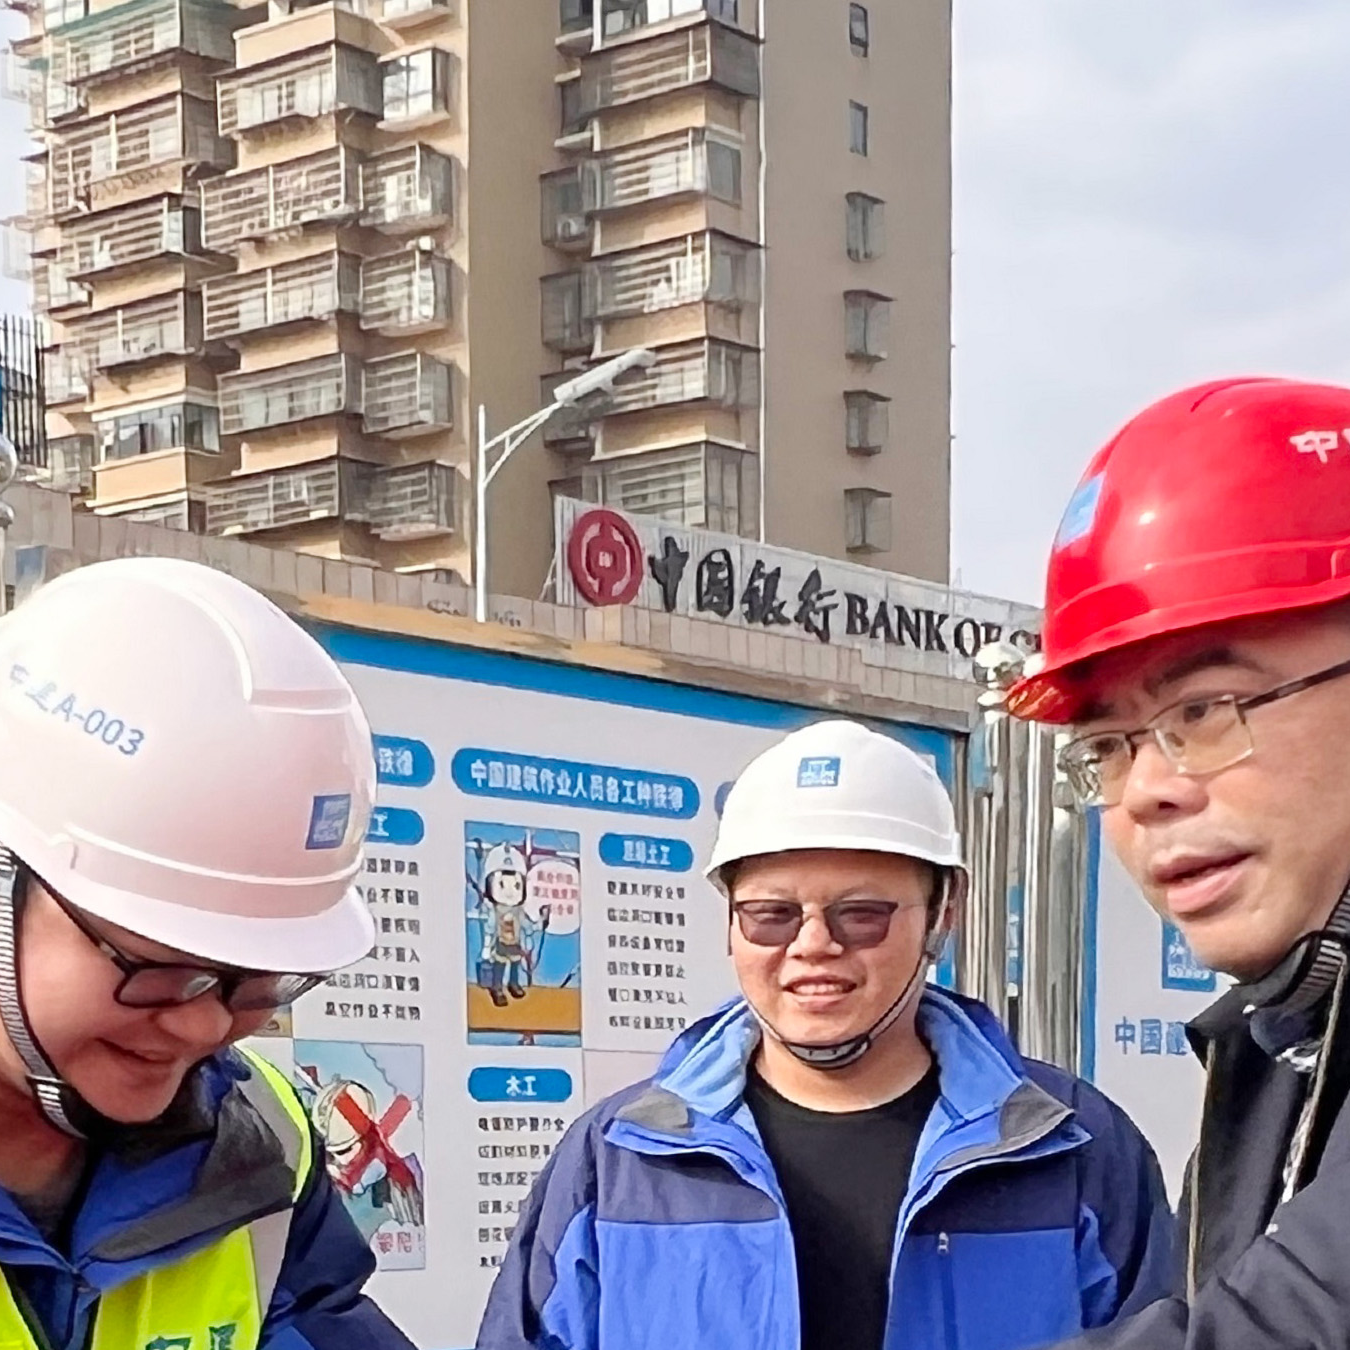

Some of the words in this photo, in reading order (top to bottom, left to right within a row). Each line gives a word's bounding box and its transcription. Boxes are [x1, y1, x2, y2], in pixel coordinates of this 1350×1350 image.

[649, 536, 838, 643] 中国银行
[846, 592, 949, 654] BANK
